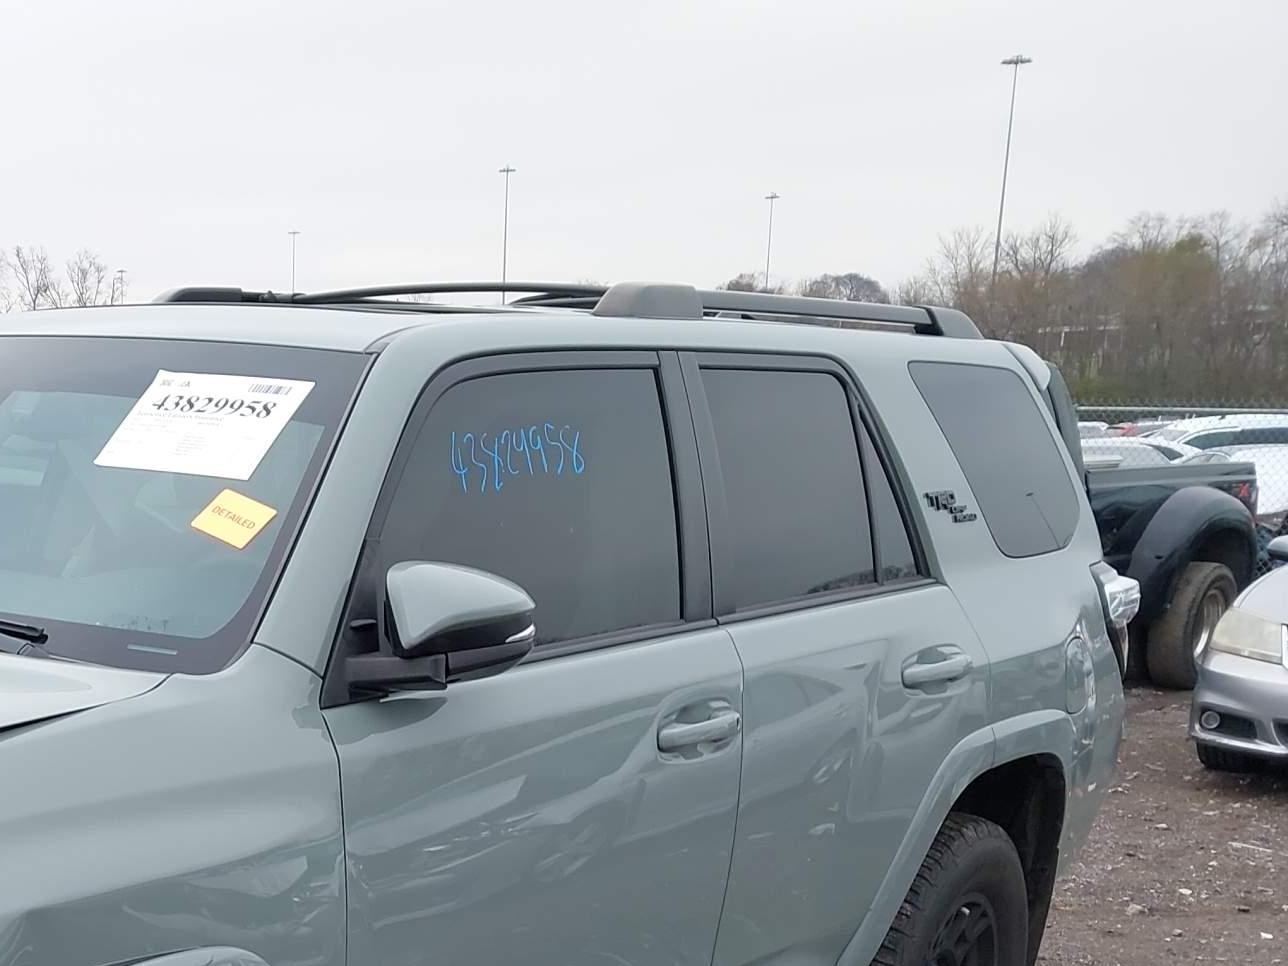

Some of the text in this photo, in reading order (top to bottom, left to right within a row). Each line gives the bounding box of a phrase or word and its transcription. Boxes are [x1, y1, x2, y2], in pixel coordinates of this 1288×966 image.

[151, 394, 278, 419] 43829958
[923, 490, 956, 510] TRD
[211, 504, 257, 531] DETAILED
